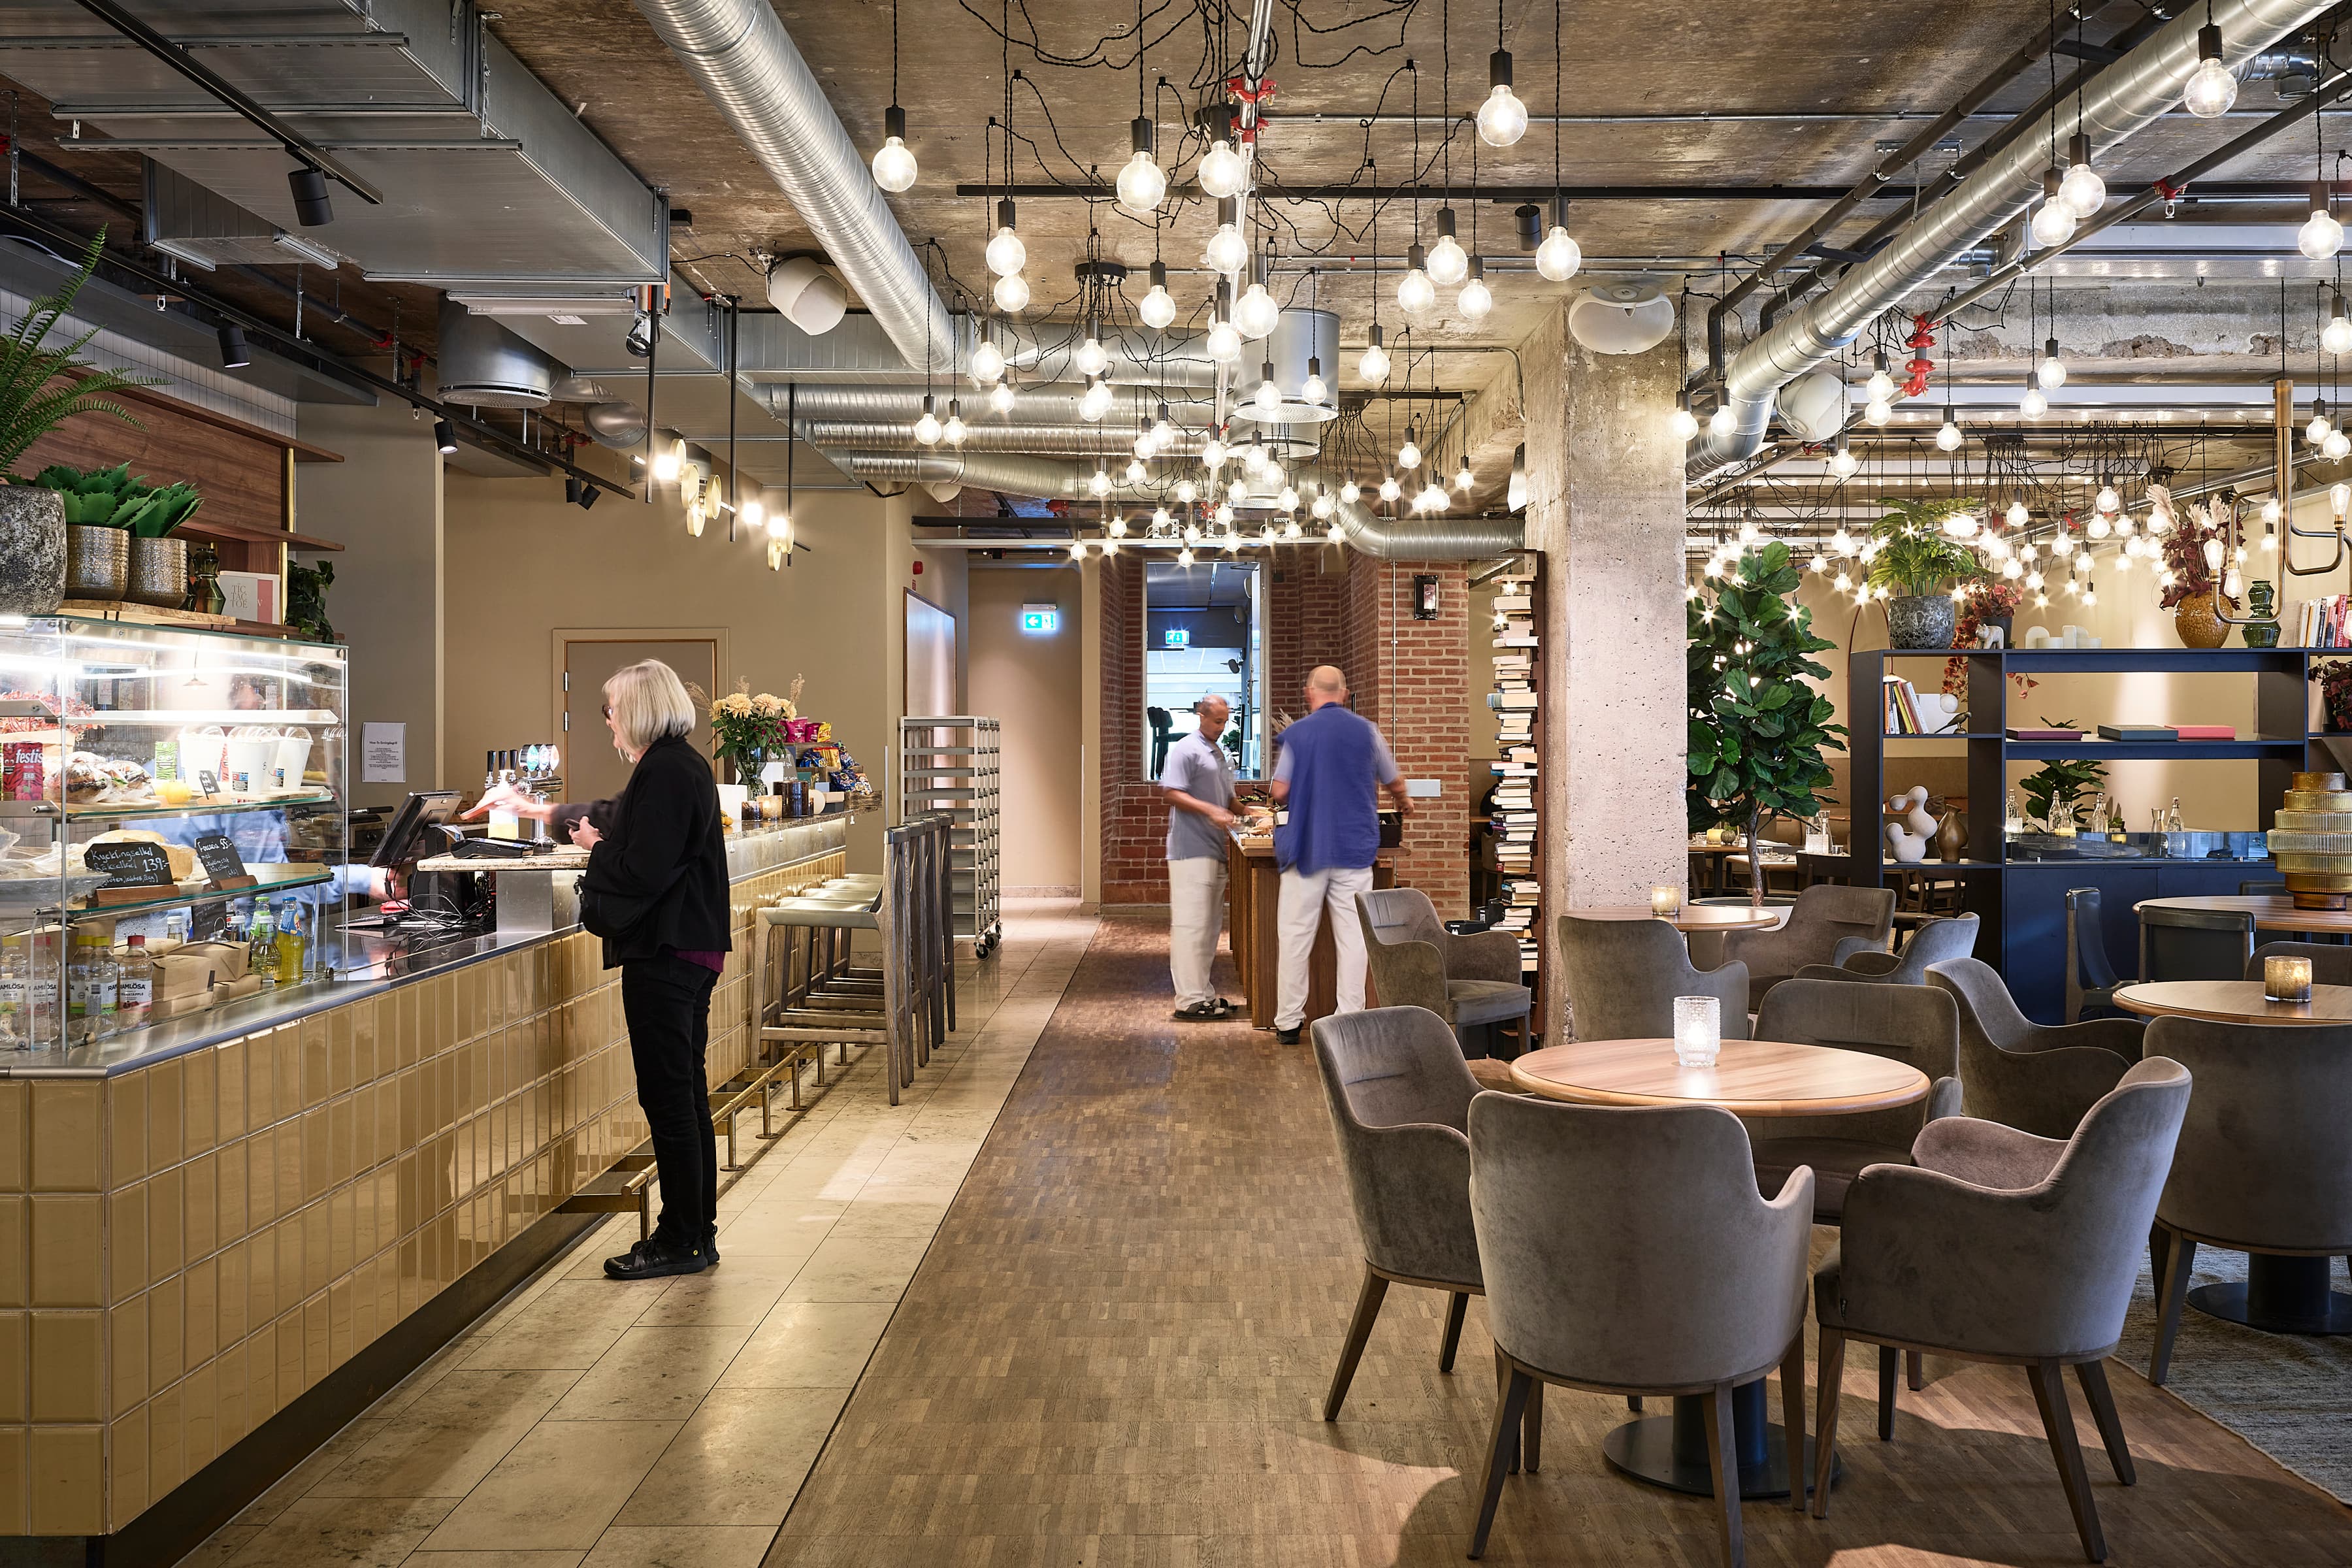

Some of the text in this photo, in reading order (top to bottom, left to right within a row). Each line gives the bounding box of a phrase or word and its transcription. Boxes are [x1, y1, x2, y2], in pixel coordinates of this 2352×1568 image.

[231, 585, 246, 593] TIC
[231, 592, 247, 601] TAC
[230, 600, 248, 608] TOE
[16, 749, 42, 763] festis
